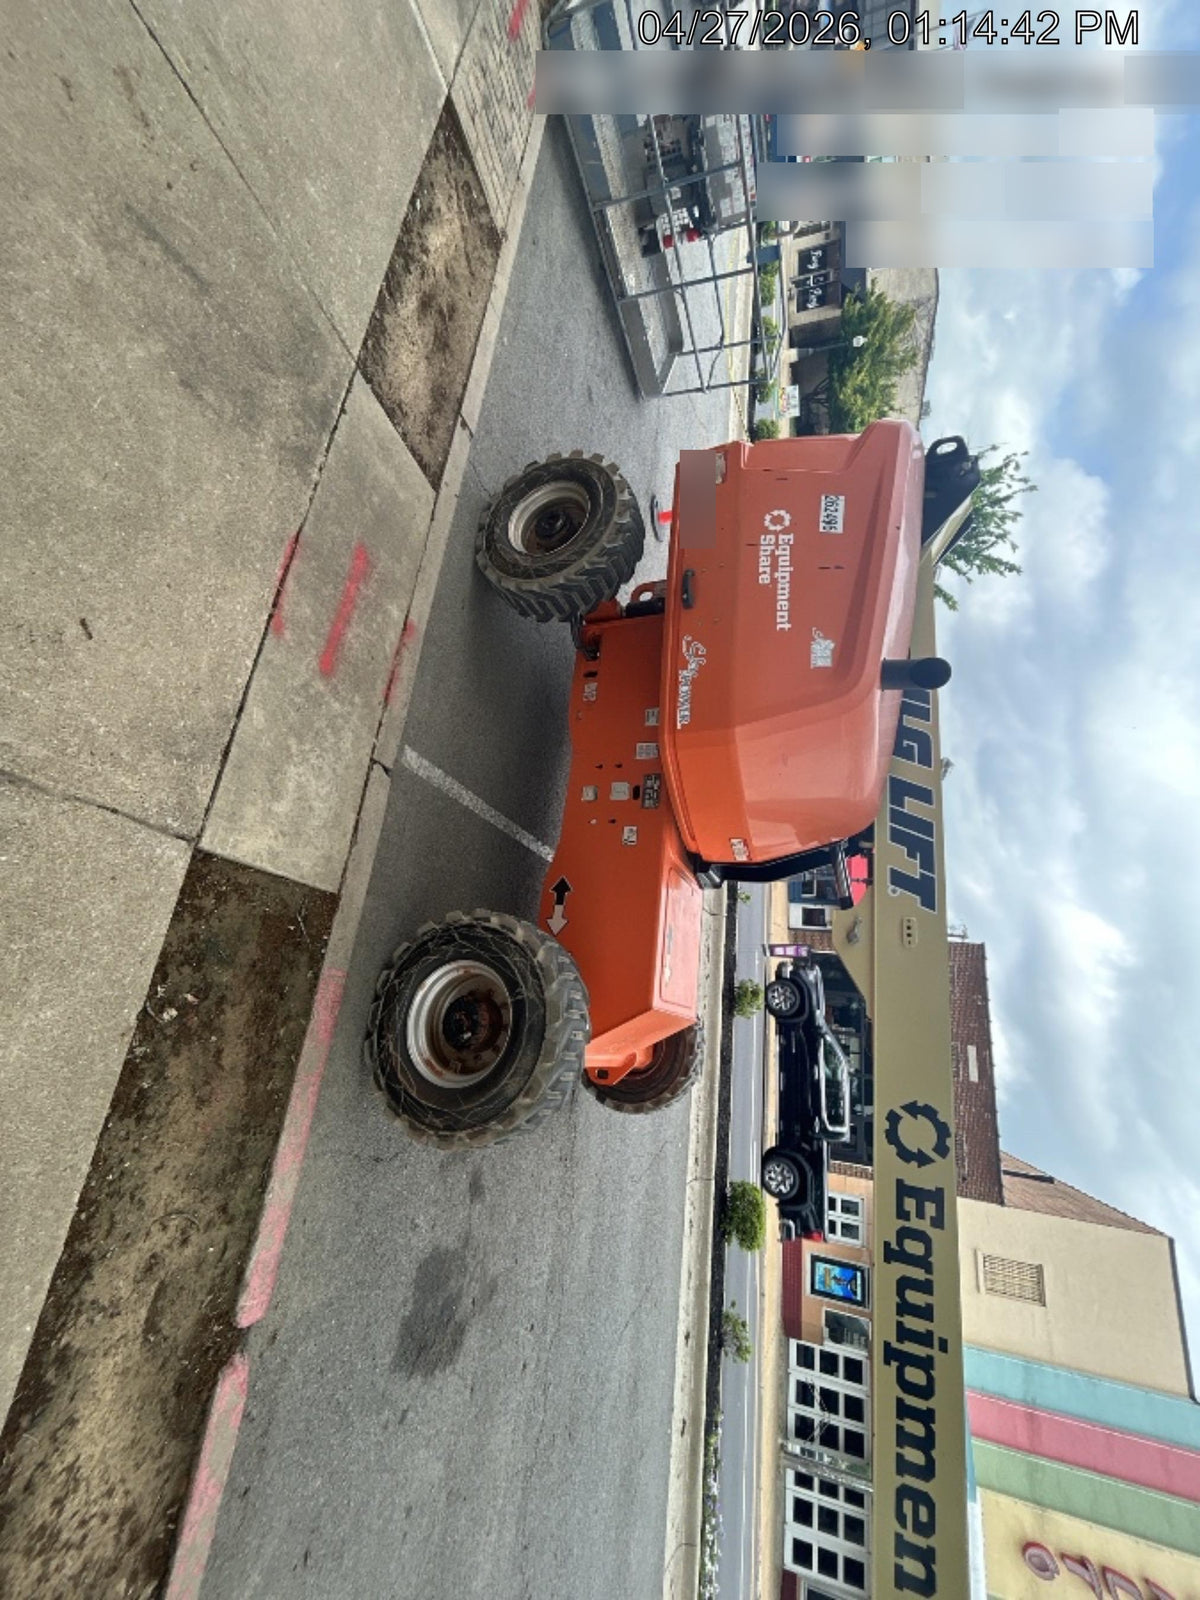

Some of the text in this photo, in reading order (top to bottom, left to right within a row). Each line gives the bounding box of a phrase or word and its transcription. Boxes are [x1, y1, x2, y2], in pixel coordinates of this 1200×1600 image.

[758, 534, 776, 585] Share
[775, 532, 794, 632] Equipment
[886, 774, 937, 915] LIFT
[883, 1178, 948, 1600] Equipmen
